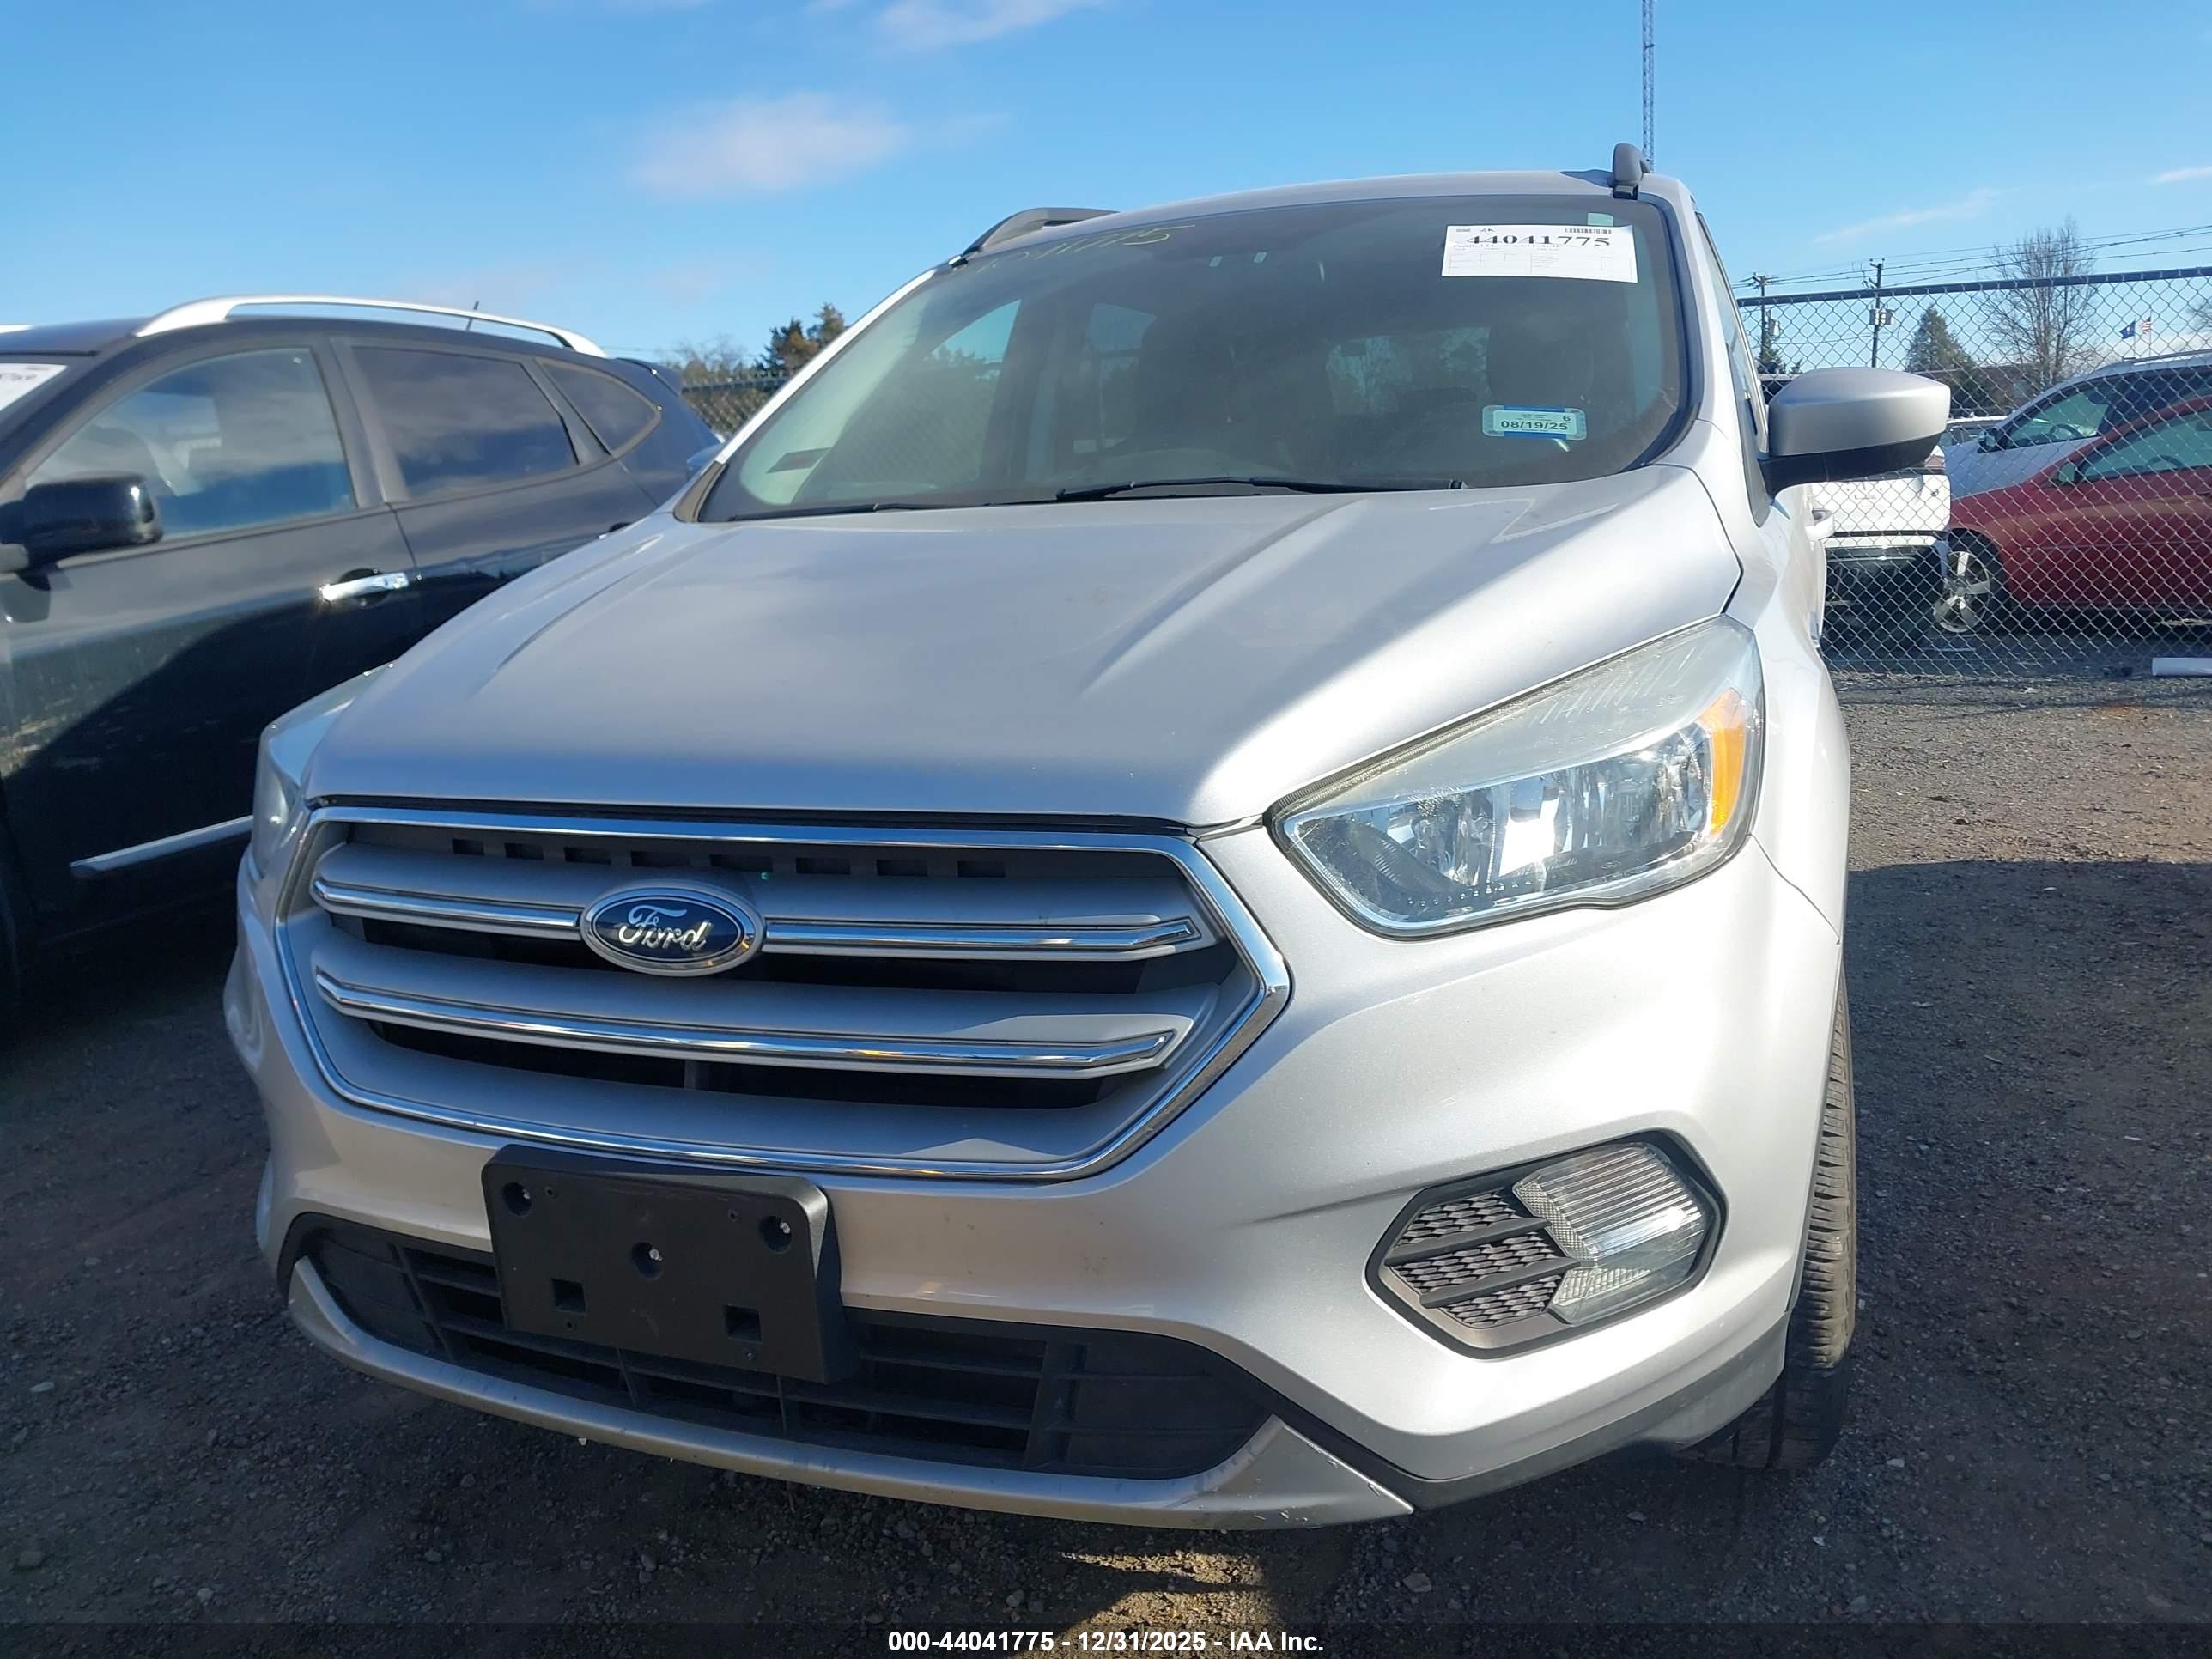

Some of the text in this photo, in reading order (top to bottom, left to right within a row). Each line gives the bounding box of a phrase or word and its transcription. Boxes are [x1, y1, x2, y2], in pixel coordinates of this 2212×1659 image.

[1466, 234, 1611, 247] 44041775
[1500, 420, 1569, 431] 08/19/25
[618, 904, 712, 951] Ford
